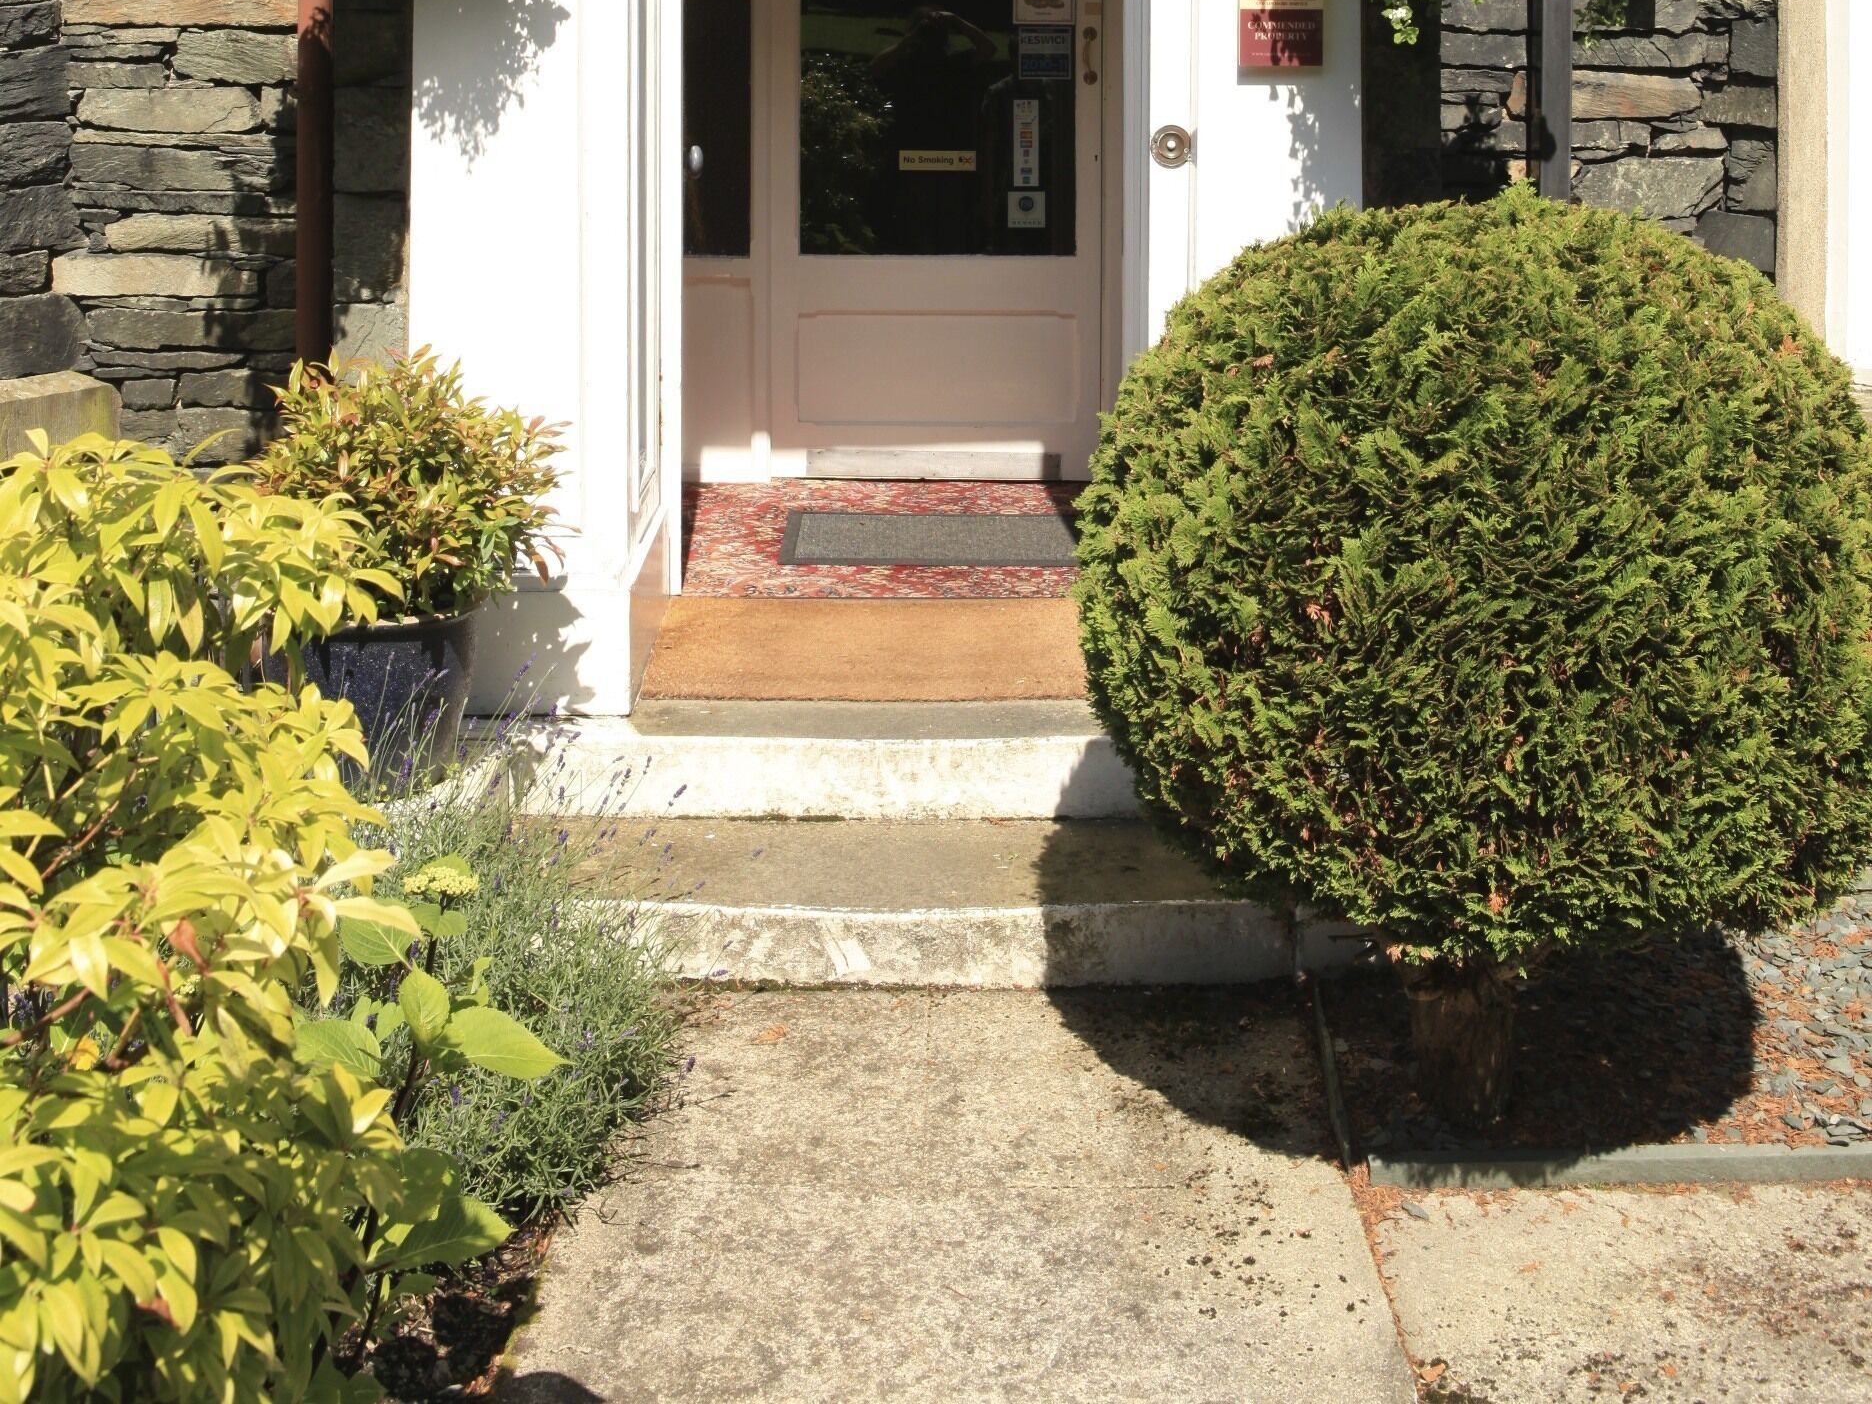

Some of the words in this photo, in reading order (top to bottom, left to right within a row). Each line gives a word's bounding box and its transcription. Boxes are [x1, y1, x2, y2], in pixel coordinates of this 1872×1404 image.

[1247, 21, 1316, 30] COMMENDED
[1254, 32, 1308, 41] PROPERTY
[903, 156, 916, 164] No
[918, 155, 954, 165] Smoking
